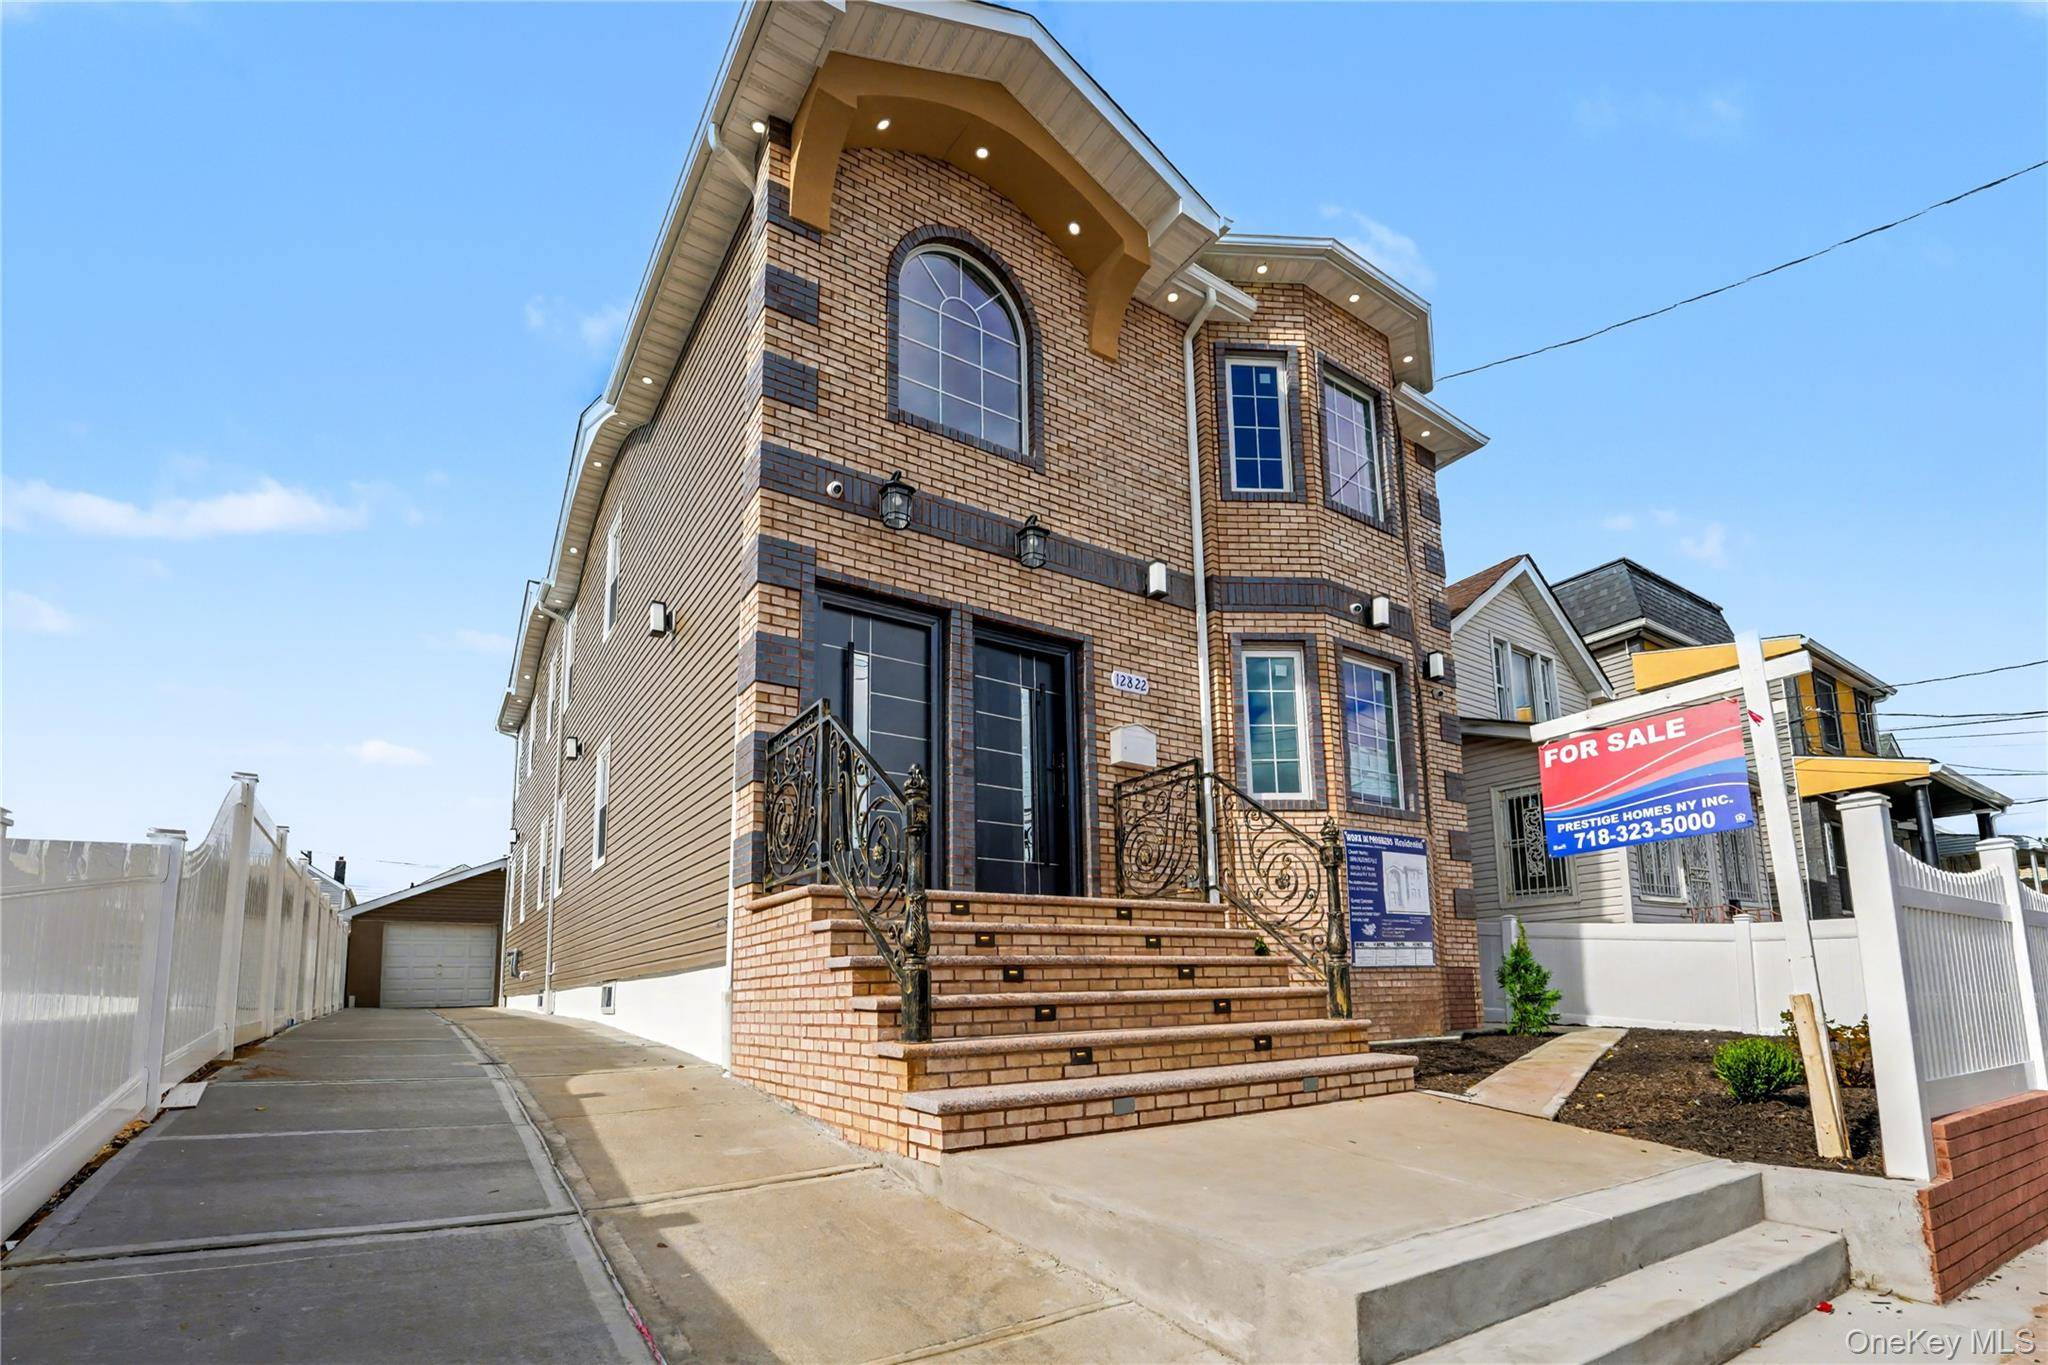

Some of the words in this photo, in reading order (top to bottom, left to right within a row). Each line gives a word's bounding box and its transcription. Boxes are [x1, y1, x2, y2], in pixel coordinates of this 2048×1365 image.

[1116, 673, 1147, 691] 12822
[1544, 739, 1599, 768] FOR
[1607, 717, 1686, 752] SALE
[1557, 812, 1620, 834] PRESTIGE
[1623, 804, 1672, 822] HOMES
[1676, 800, 1697, 812] NY
[1701, 794, 1733, 807] INC.
[1574, 810, 1715, 849] 718-323-5000
